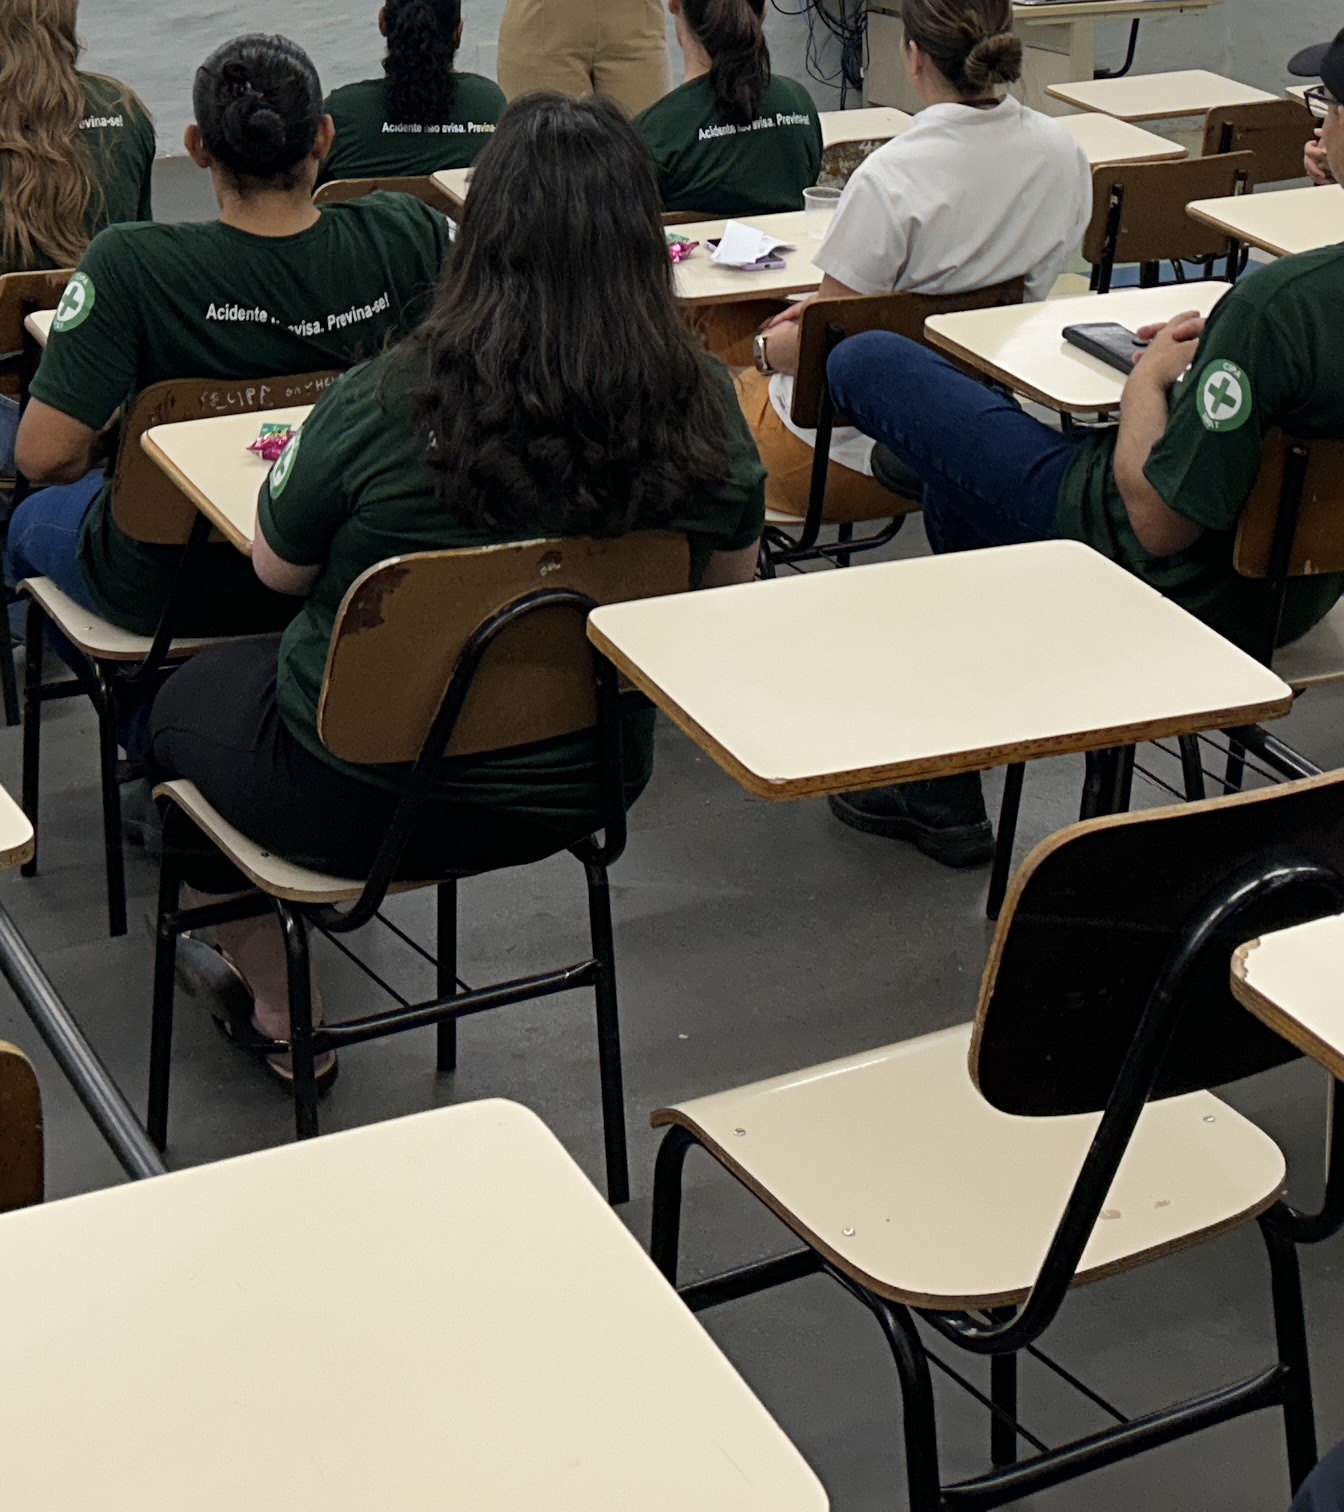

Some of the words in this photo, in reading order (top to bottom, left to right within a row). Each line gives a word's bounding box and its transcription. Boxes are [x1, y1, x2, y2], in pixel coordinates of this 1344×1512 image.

[79, 114, 124, 130] evina-se!
[698, 124, 737, 141] Acidente
[206, 302, 268, 323] Acidente
[327, 291, 390, 331] Previna-se!
